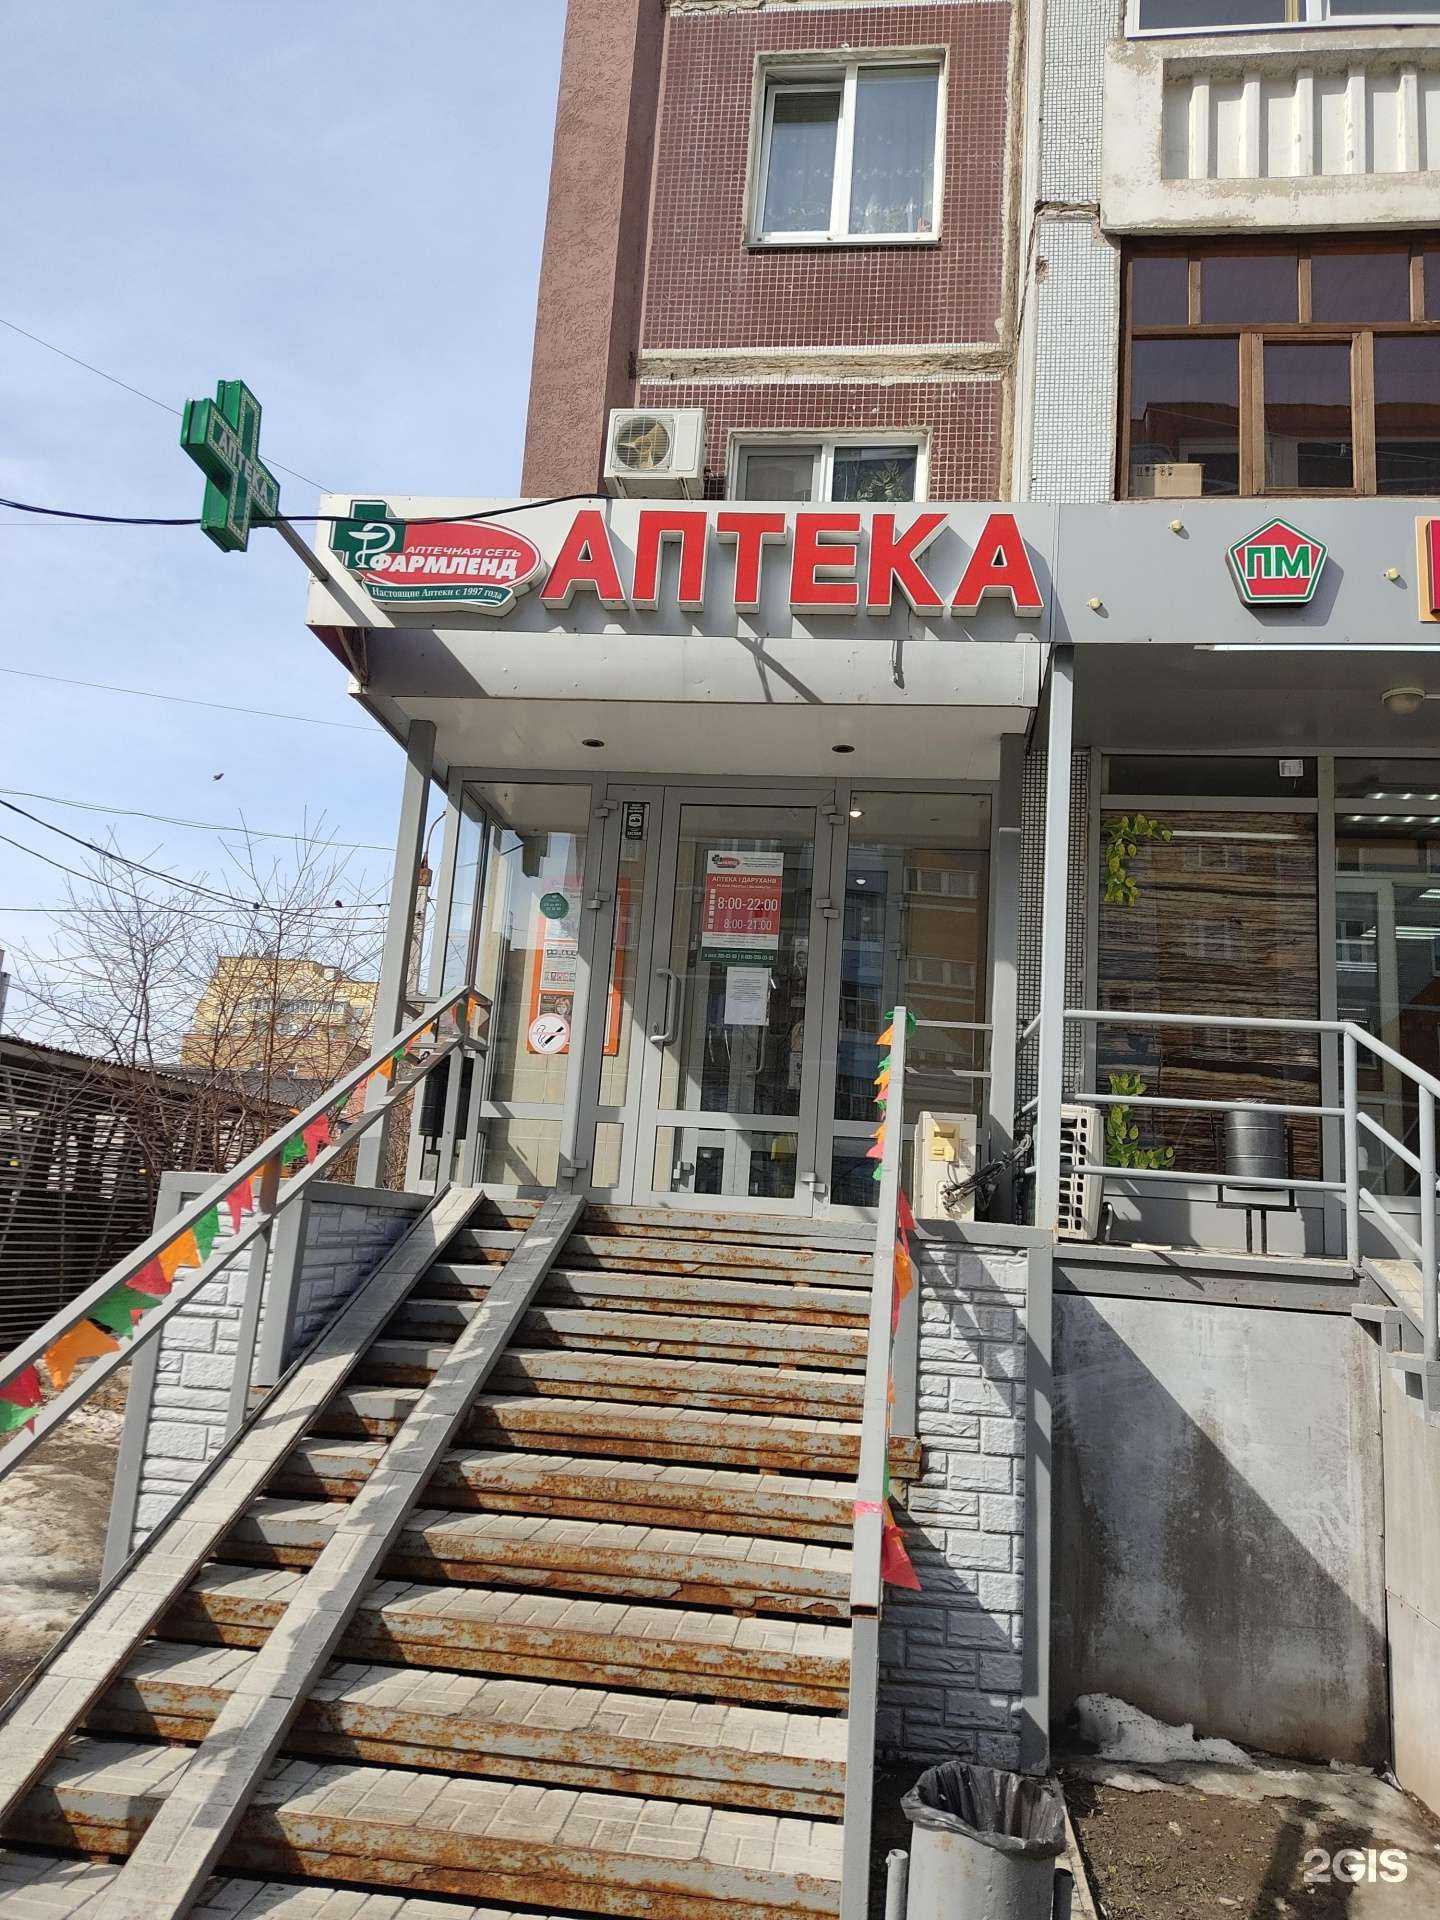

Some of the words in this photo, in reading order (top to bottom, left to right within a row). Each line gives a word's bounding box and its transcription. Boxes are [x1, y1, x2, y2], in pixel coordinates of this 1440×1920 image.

[218, 431, 269, 501] АПТЕКА
[405, 545, 482, 556] АПТЕЧНАЯ
[484, 547, 523, 558] СЕТЬ
[540, 509, 1045, 612] АПТЕКА
[1244, 544, 1313, 579] ПМ
[369, 553, 518, 580] ФАРМЛЕНД
[372, 586, 420, 599] Настоящие
[422, 588, 454, 598] Аптеки
[463, 587, 484, 597] 1997
[484, 589, 503, 600] года
[711, 875, 737, 883] АПТЕКА
[717, 896, 778, 912] 8:00-22:00
